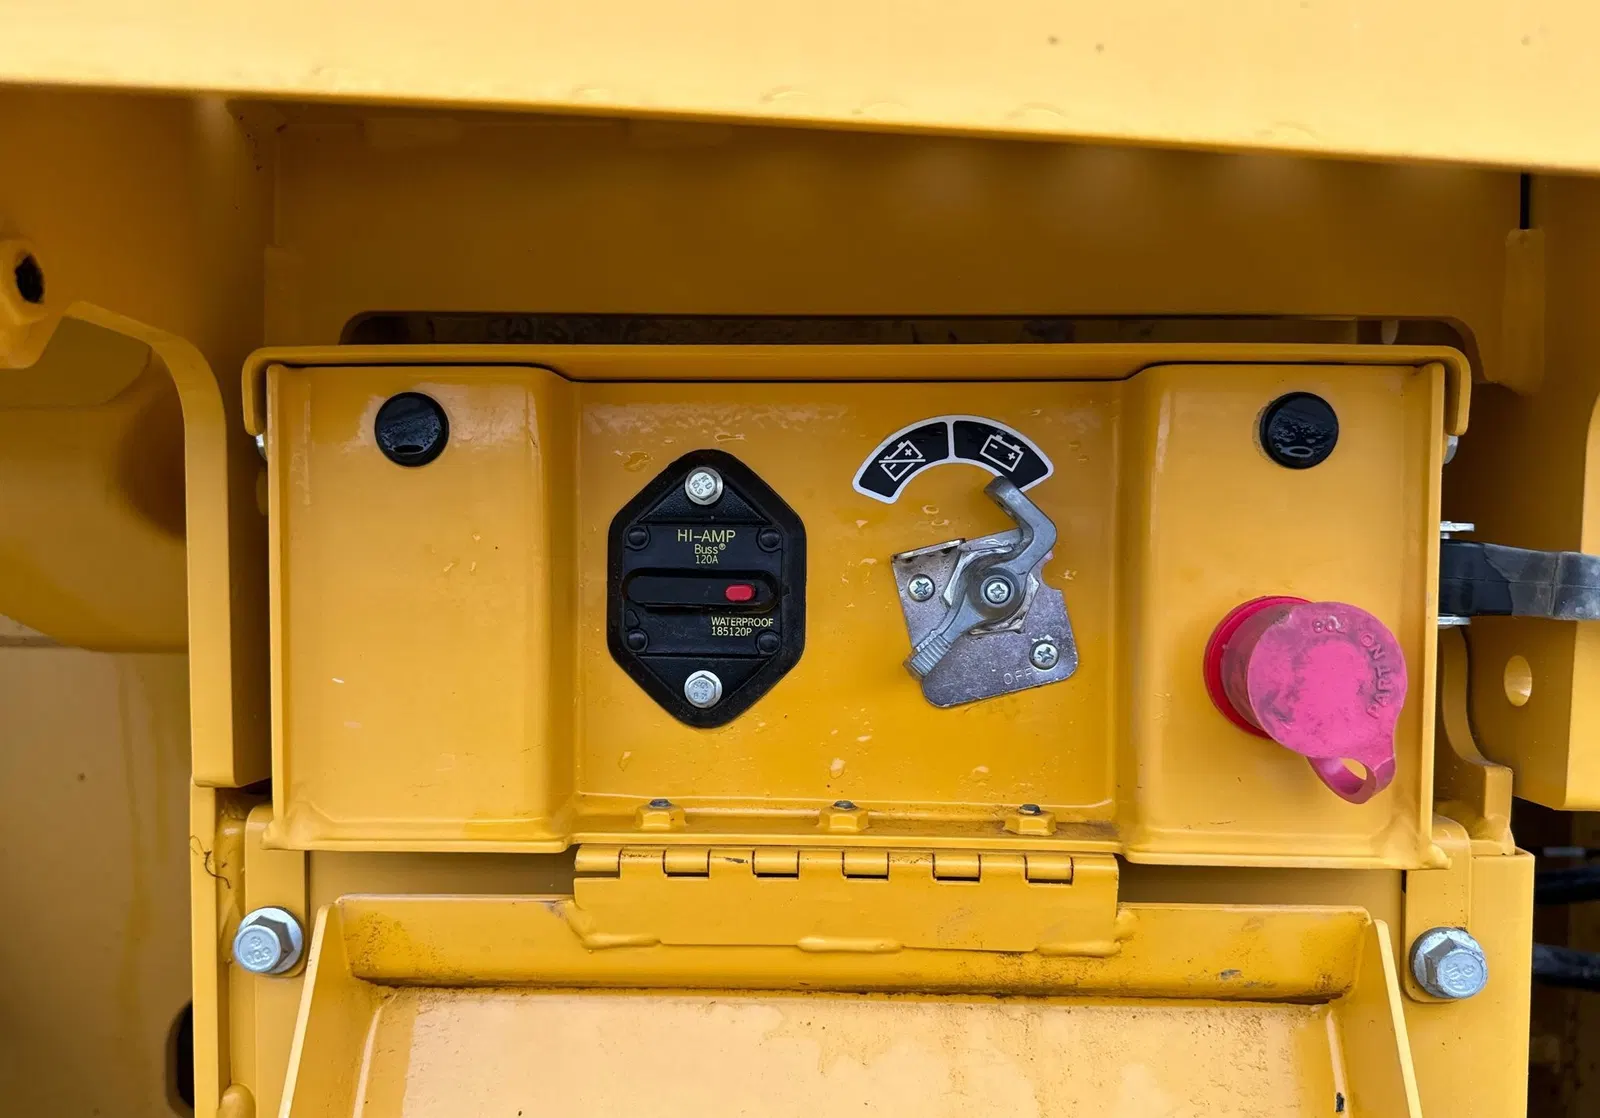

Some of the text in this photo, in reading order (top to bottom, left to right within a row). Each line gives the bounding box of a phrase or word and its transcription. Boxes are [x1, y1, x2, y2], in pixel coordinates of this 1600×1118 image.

[677, 529, 736, 543] HI-AMP
[695, 554, 719, 564] 120A
[711, 616, 774, 627] WATERPROOF
[711, 626, 752, 637] 185120P
[1003, 667, 1033, 685] OFF
[1366, 666, 1391, 719] PART
